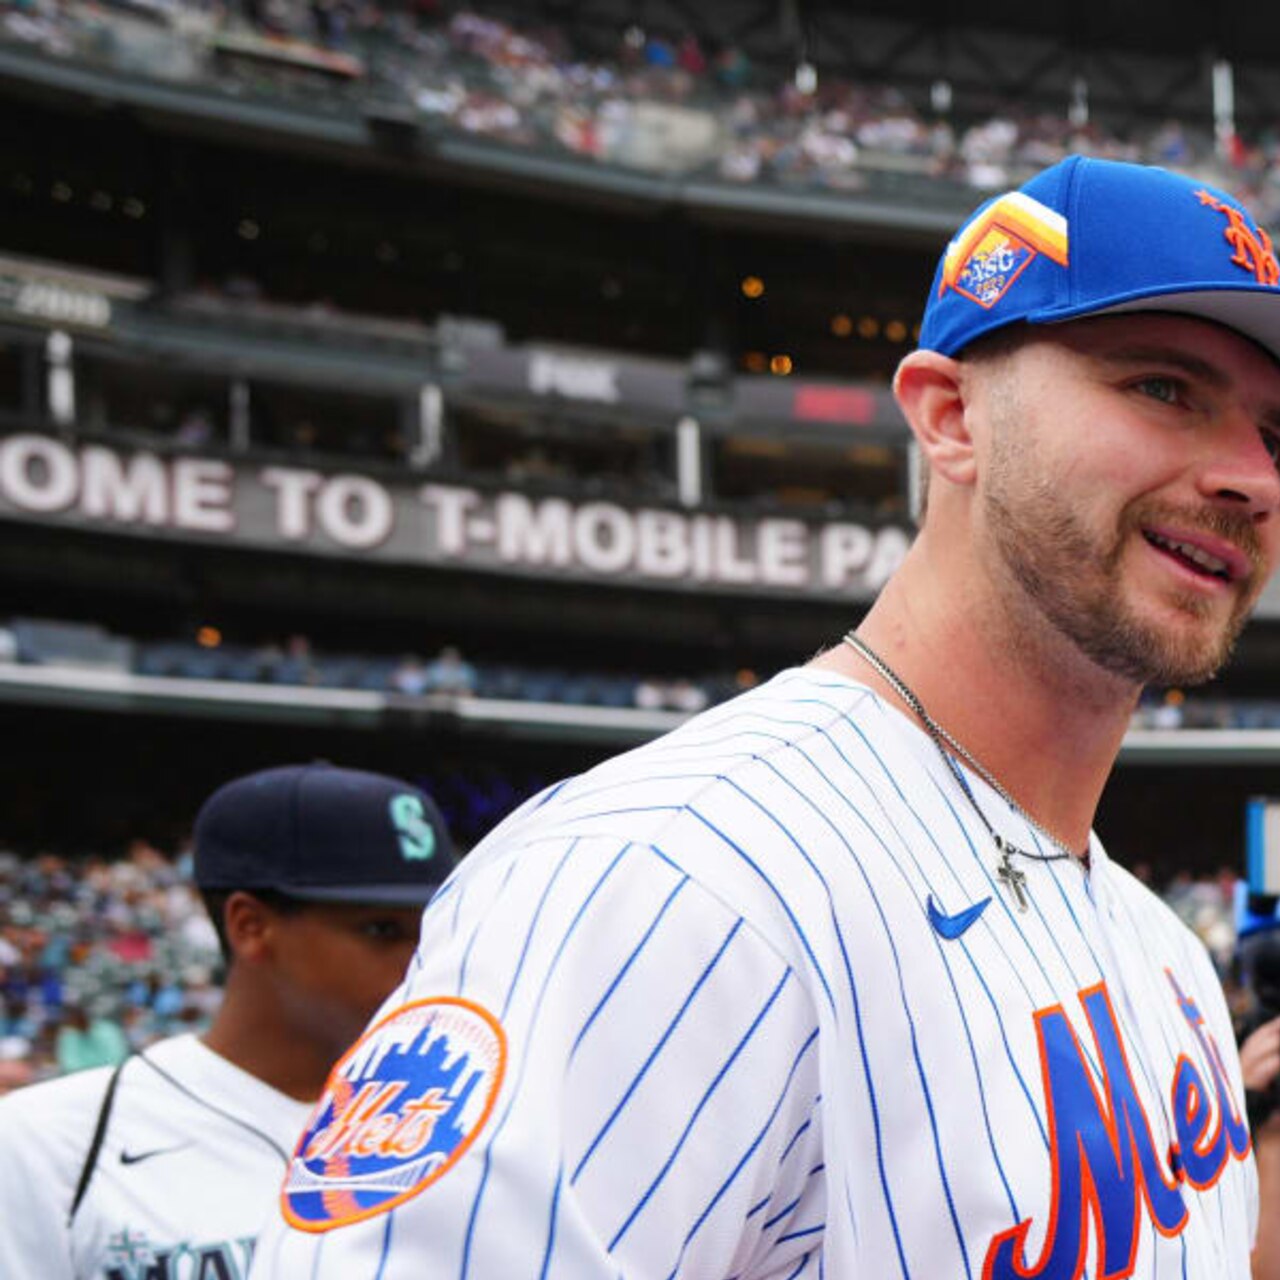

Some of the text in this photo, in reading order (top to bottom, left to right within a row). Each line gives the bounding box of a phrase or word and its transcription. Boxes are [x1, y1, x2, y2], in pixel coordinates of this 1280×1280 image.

[260, 466, 394, 549] TO
[421, 483, 808, 586] T-MOBILE
[388, 793, 436, 861] S
[304, 1080, 454, 1161] Mets
